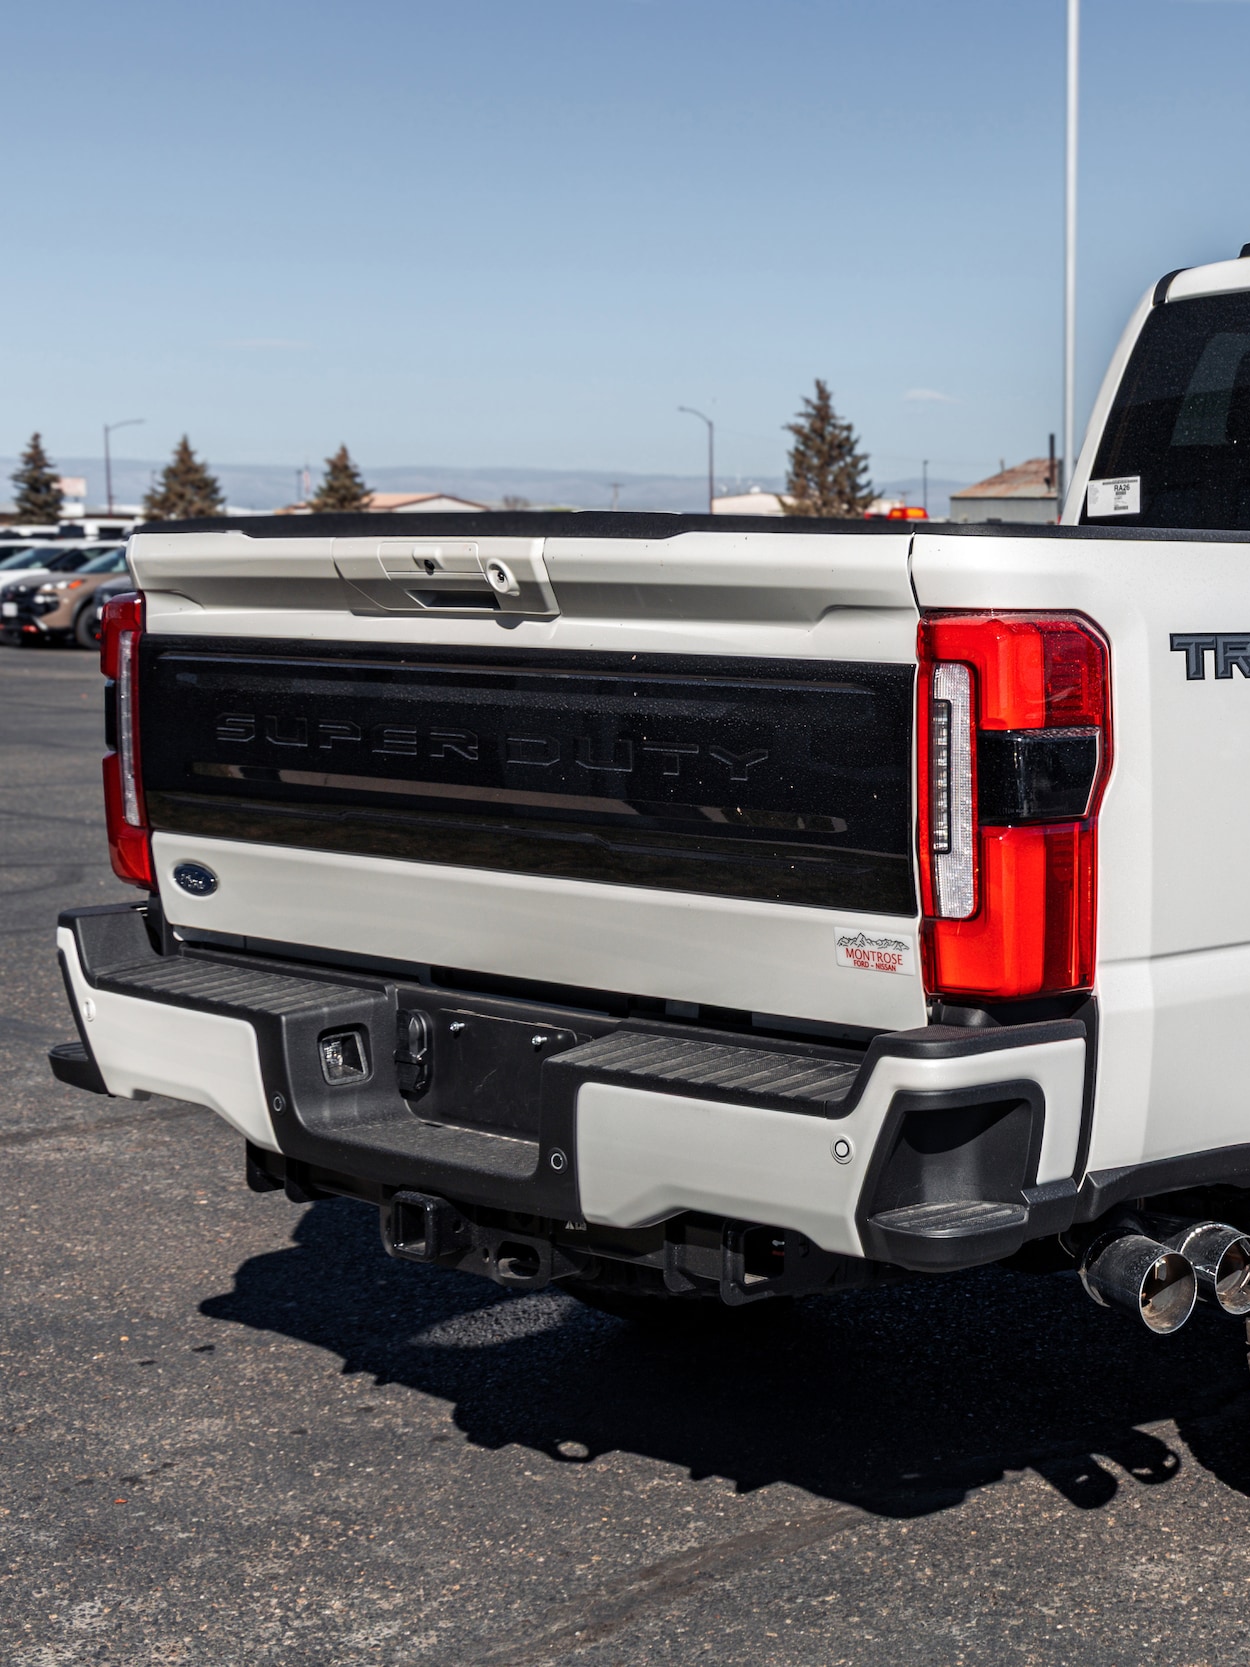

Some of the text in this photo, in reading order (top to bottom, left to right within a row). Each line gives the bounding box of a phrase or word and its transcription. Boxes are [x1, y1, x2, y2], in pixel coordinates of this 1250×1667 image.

[214, 710, 770, 782] SUPER DUTY
[845, 947, 904, 966] MONTROSE
[853, 959, 870, 968] FORD
[875, 962, 897, 972] NISSAN
